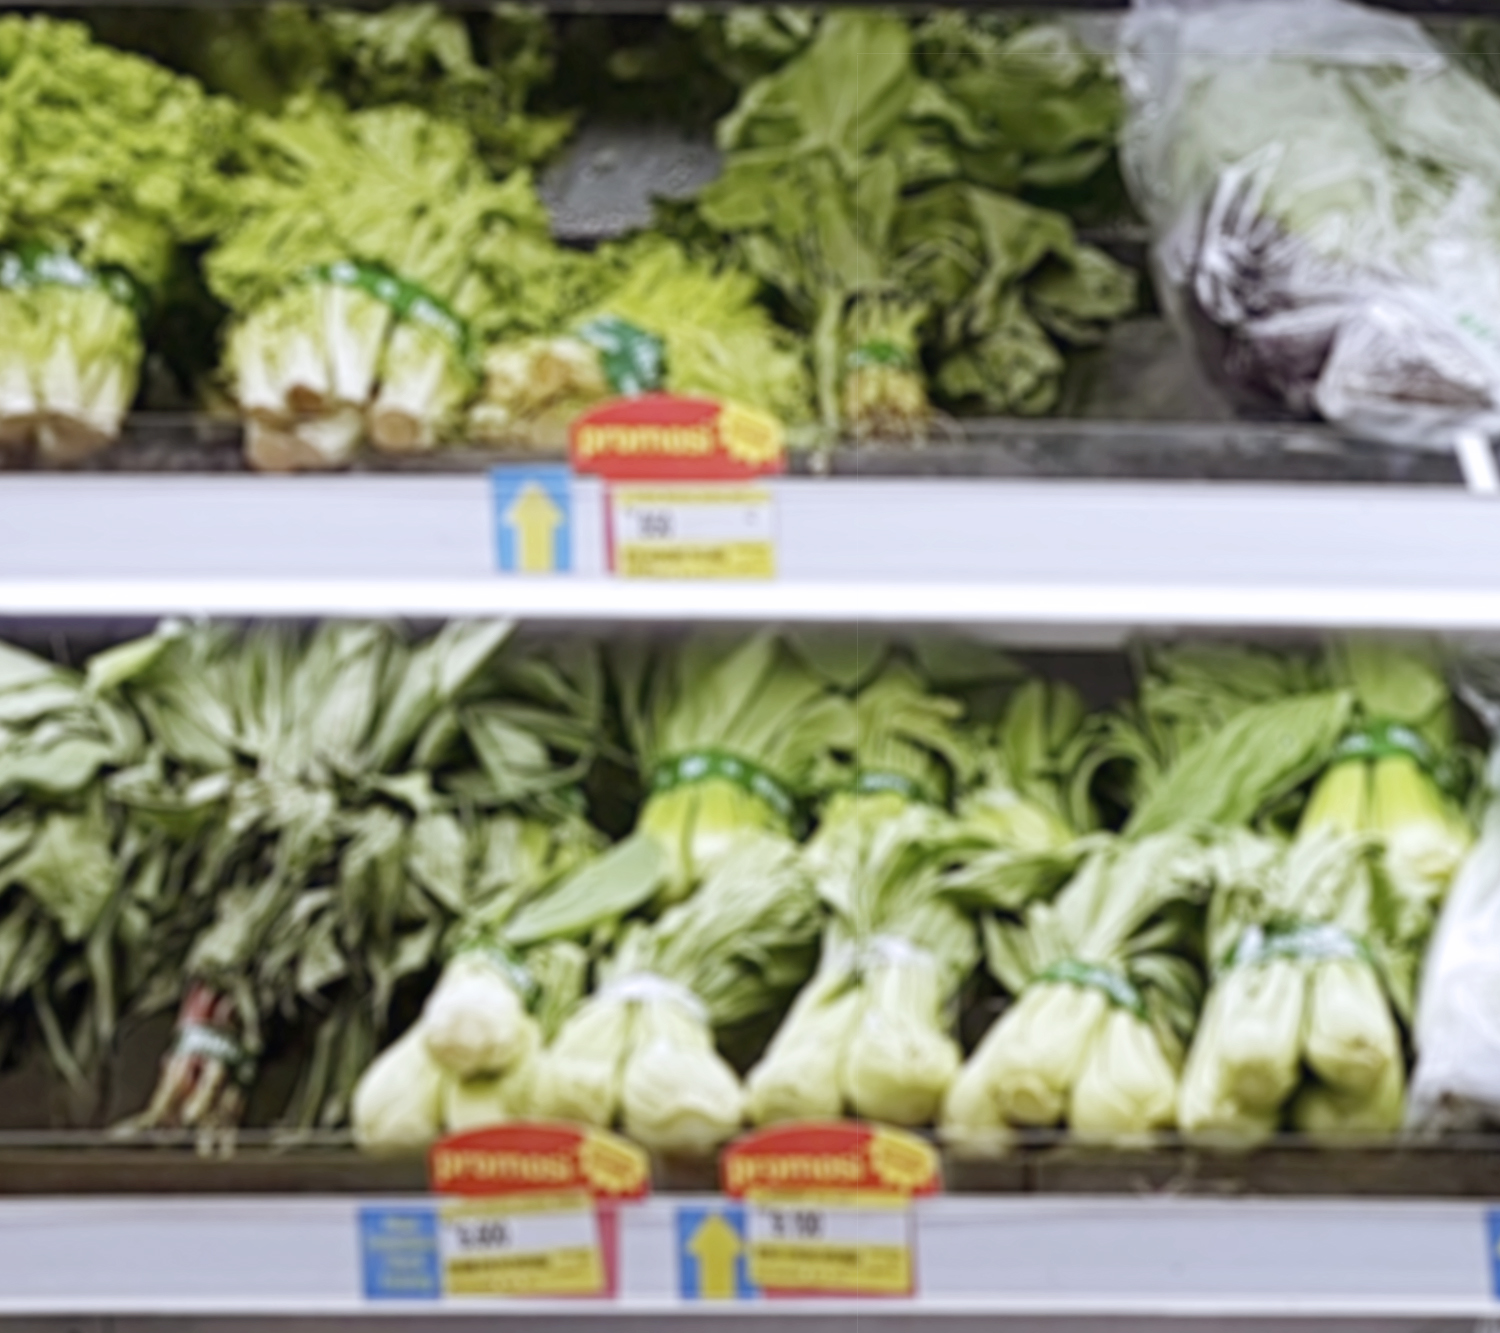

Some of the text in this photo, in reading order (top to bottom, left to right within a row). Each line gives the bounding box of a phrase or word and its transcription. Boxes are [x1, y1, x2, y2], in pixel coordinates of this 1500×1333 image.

[578, 422, 716, 456] promosi
[434, 1146, 573, 1181] promosi
[729, 1151, 861, 1184] promosi
